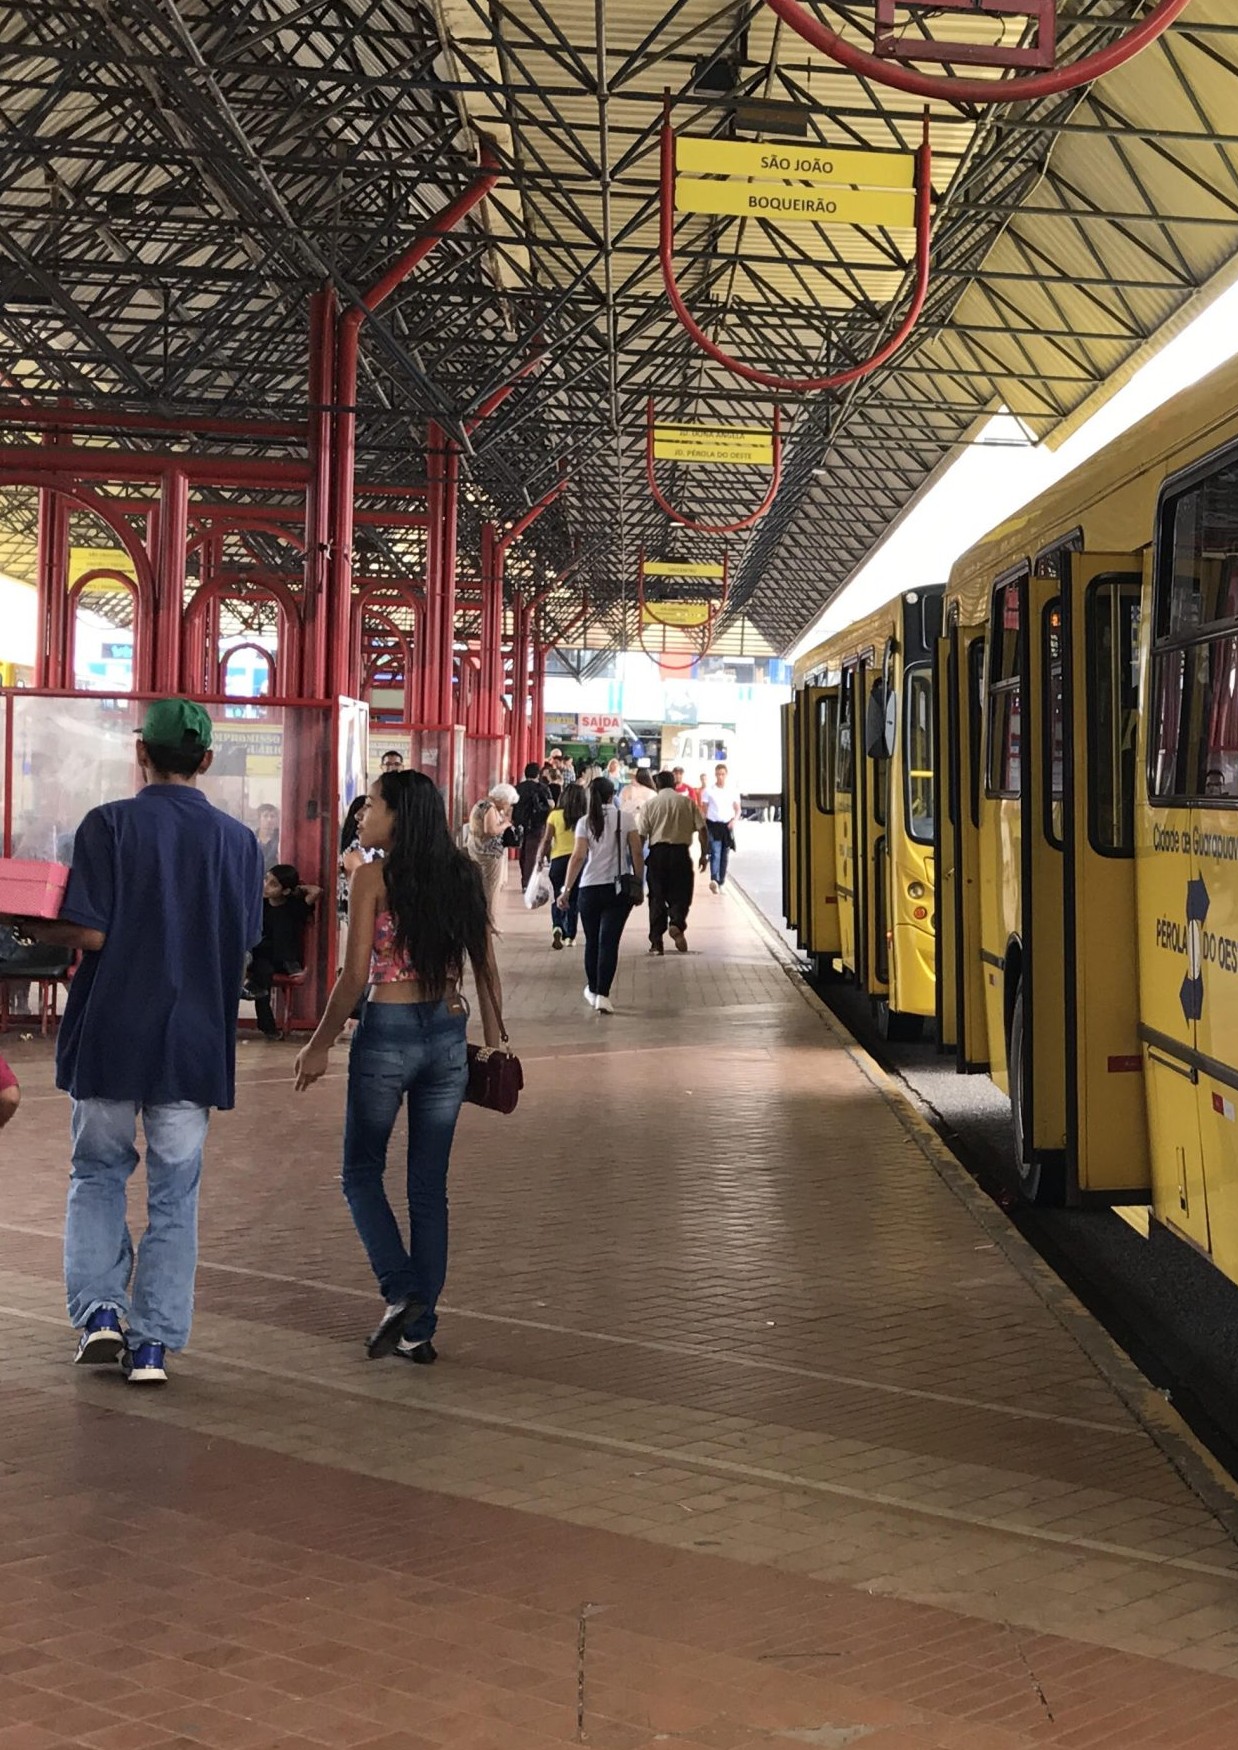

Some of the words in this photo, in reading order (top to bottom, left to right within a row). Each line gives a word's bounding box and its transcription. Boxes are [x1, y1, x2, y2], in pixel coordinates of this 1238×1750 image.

[760, 154, 790, 171] SÃO
[794, 157, 834, 174] JOÃO
[748, 195, 837, 214] BOQUEIRÃO
[687, 449, 715, 458] PÉROLA
[582, 714, 619, 727] SAÍDA
[1153, 822, 1180, 853] Cidade
[1156, 914, 1188, 956] PÉROLA
[1203, 931, 1217, 962] DO
